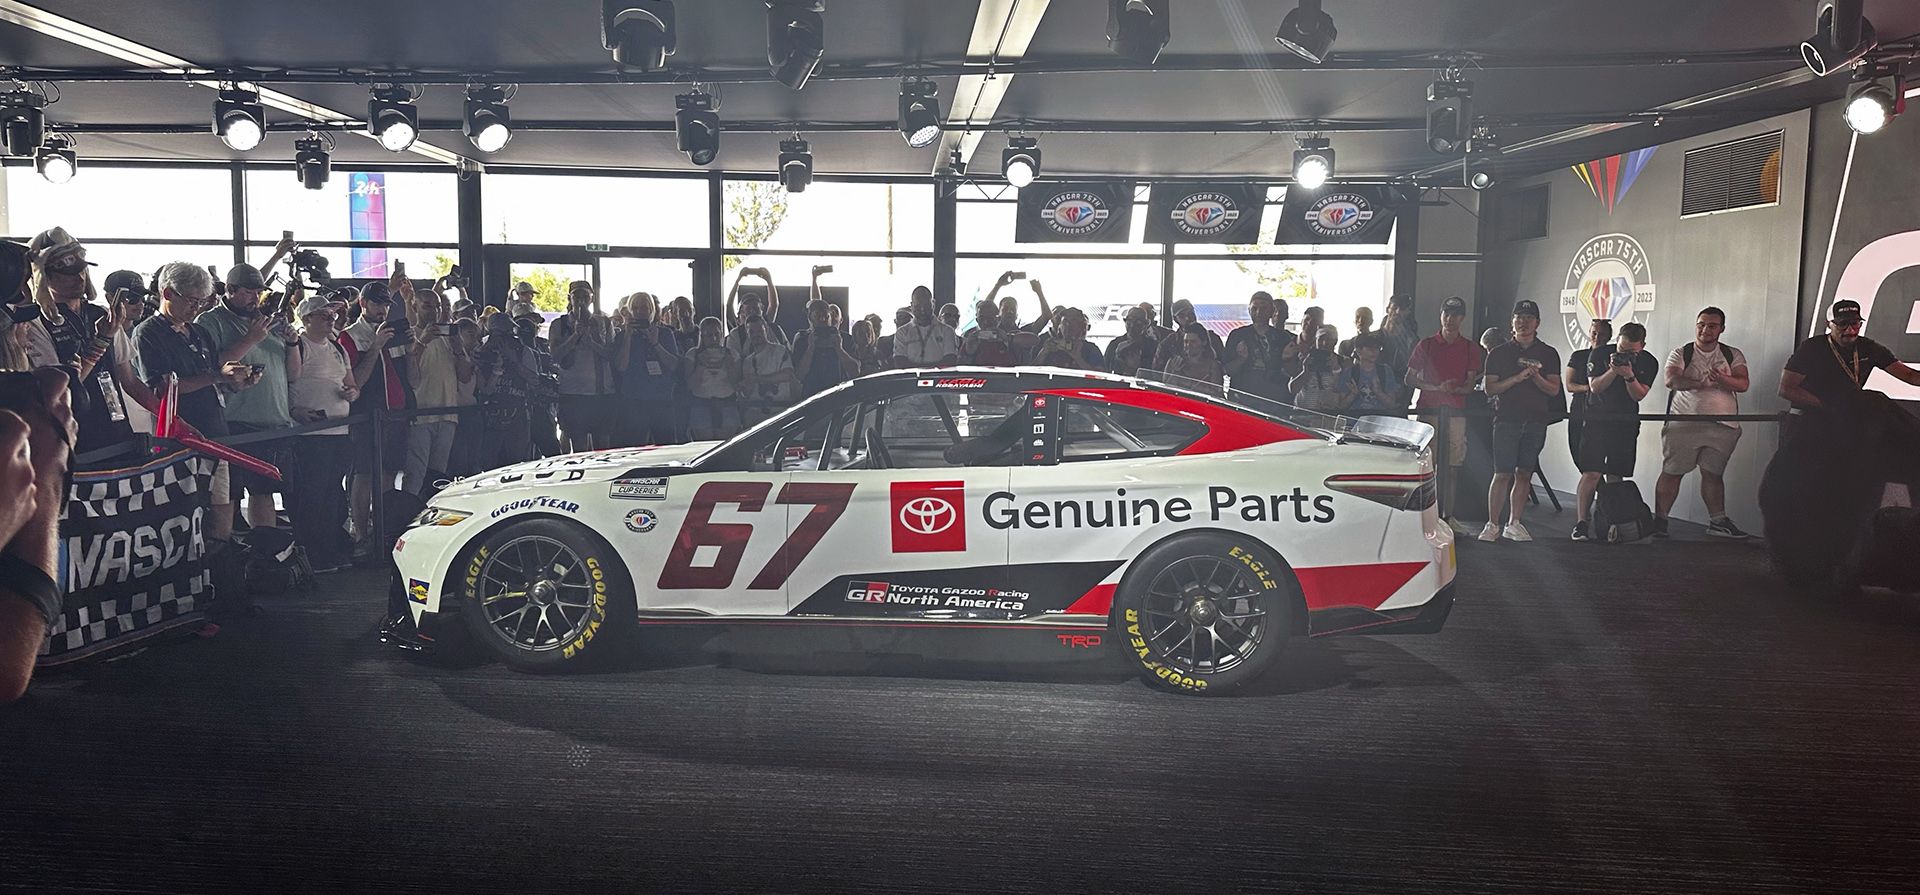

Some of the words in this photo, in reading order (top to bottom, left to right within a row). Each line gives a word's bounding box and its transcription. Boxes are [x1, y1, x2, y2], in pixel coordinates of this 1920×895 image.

[1051, 193, 1080, 207] NASCAR
[1083, 193, 1101, 207] 75TH
[1182, 194, 1212, 207] NASCAR
[1214, 194, 1232, 208] 75TH
[1317, 195, 1348, 208] NASCAR
[1350, 195, 1367, 208] 75TH
[1048, 219, 1100, 234] ANNIVERSARY
[1178, 220, 1229, 235] ANNIVERSARY
[1311, 221, 1362, 235] ANNIVERSARY
[1573, 239, 1613, 279] NASCAR
[1616, 239, 1644, 275] 75TH
[1562, 296, 1576, 306] 1948
[1637, 292, 1653, 303] 2023
[490, 495, 580, 519] GOODYEAR
[982, 487, 1193, 530] Genuine
[1208, 486, 1336, 524] Parts
[657, 481, 858, 590] 67
[68, 506, 206, 593] NASCA
[465, 545, 491, 599] EAGLE
[1228, 545, 1278, 591] EAGLE
[847, 588, 883, 602] GR
[890, 584, 940, 594] TOYOTA
[941, 587, 986, 596] GAZOO
[987, 588, 1030, 600] Racing
[562, 557, 607, 660] GOODYEAR
[886, 593, 940, 605] North
[944, 596, 1025, 611] America
[1057, 634, 1102, 648] TRD
[1125, 608, 1208, 691] GOODYEAR
